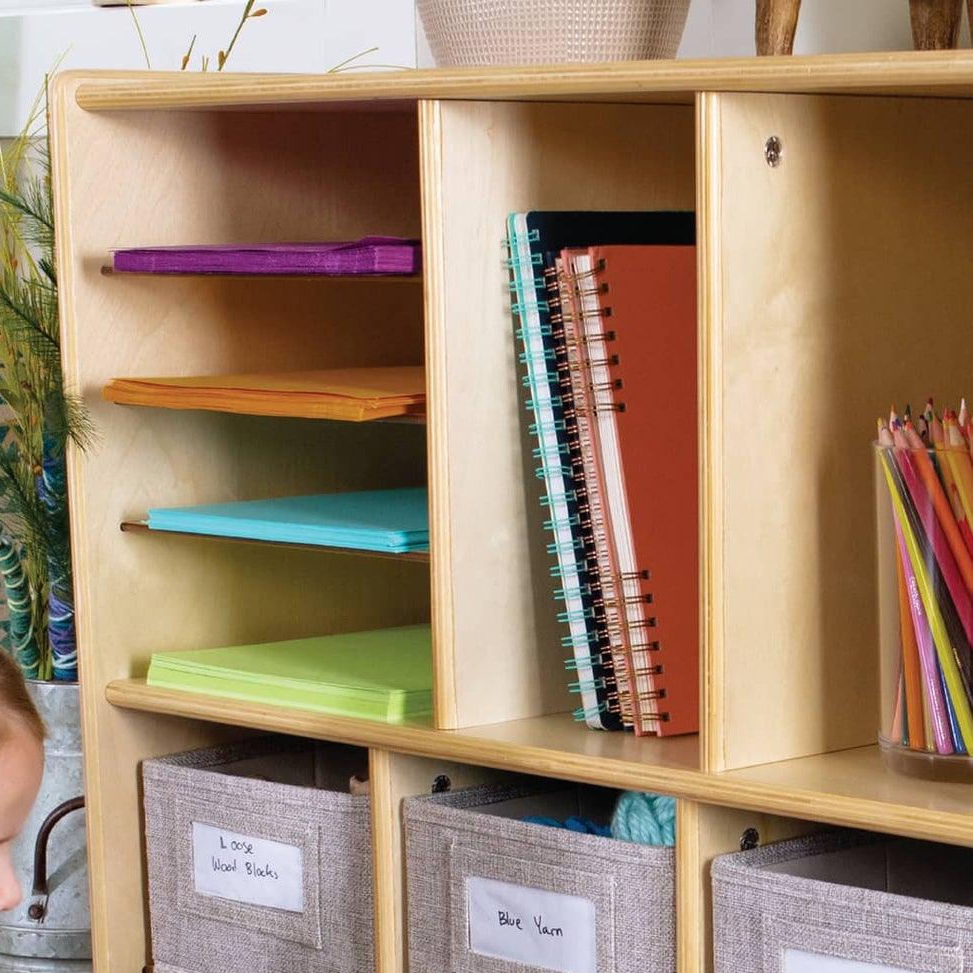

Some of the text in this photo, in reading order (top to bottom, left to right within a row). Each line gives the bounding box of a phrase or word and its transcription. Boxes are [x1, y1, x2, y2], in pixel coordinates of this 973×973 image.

[219, 835, 254, 855] Loose
[211, 855, 279, 880] Wood Blocks
[497, 910, 564, 937] Blue Yarn
